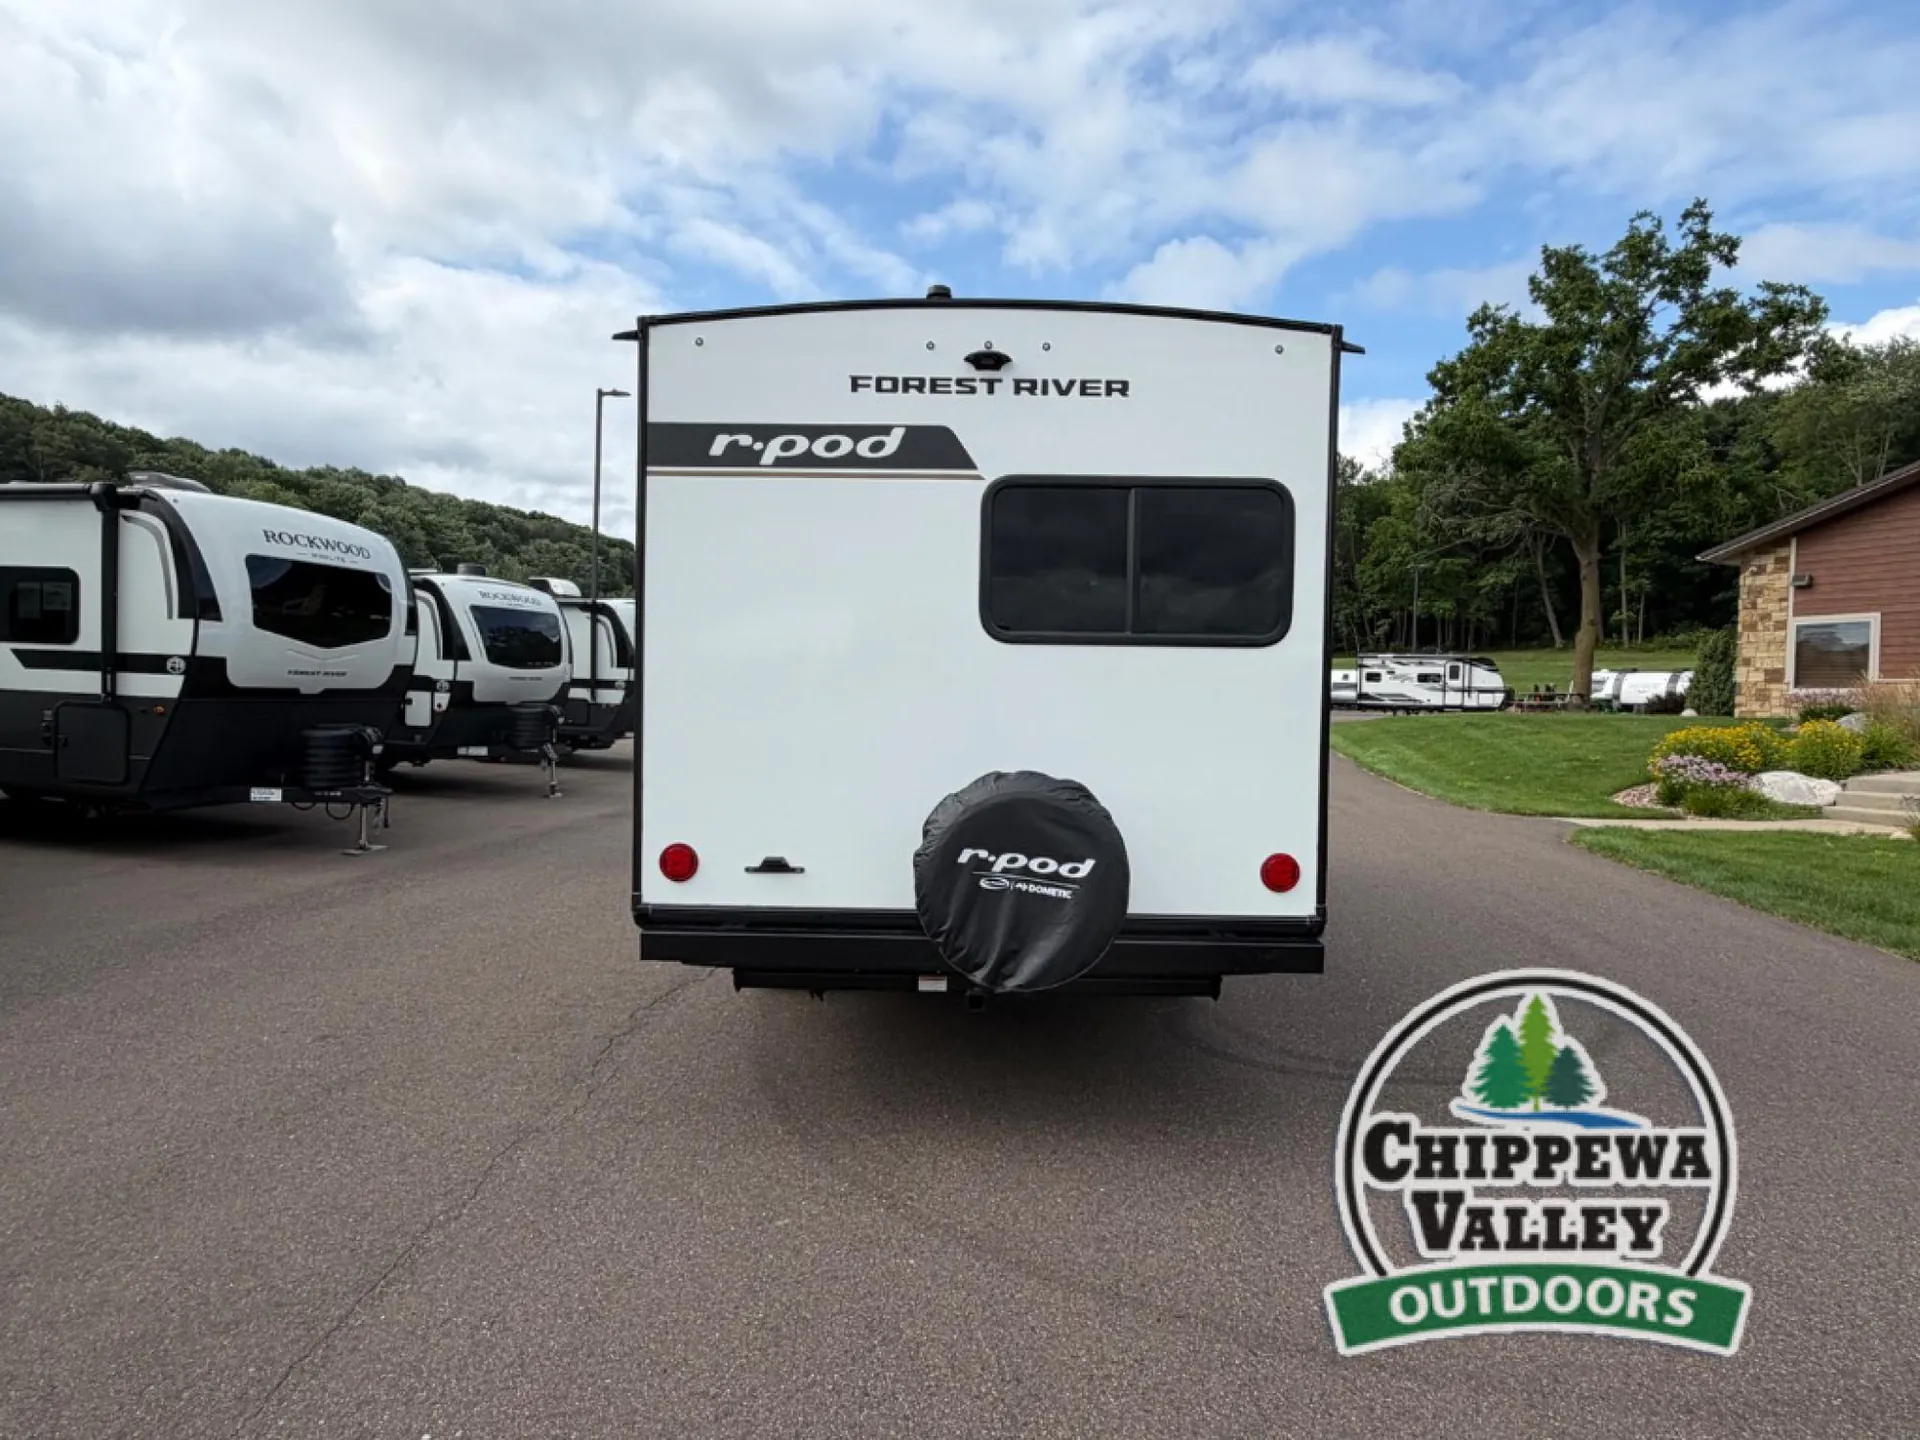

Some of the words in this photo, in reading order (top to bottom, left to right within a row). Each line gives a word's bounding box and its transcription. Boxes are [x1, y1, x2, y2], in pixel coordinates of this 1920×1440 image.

[849, 375, 1003, 395] FOREST
[1013, 378, 1130, 397] RIVER
[262, 529, 371, 559] ROCKWOOD
[1028, 884, 1073, 899] DOMETIC
